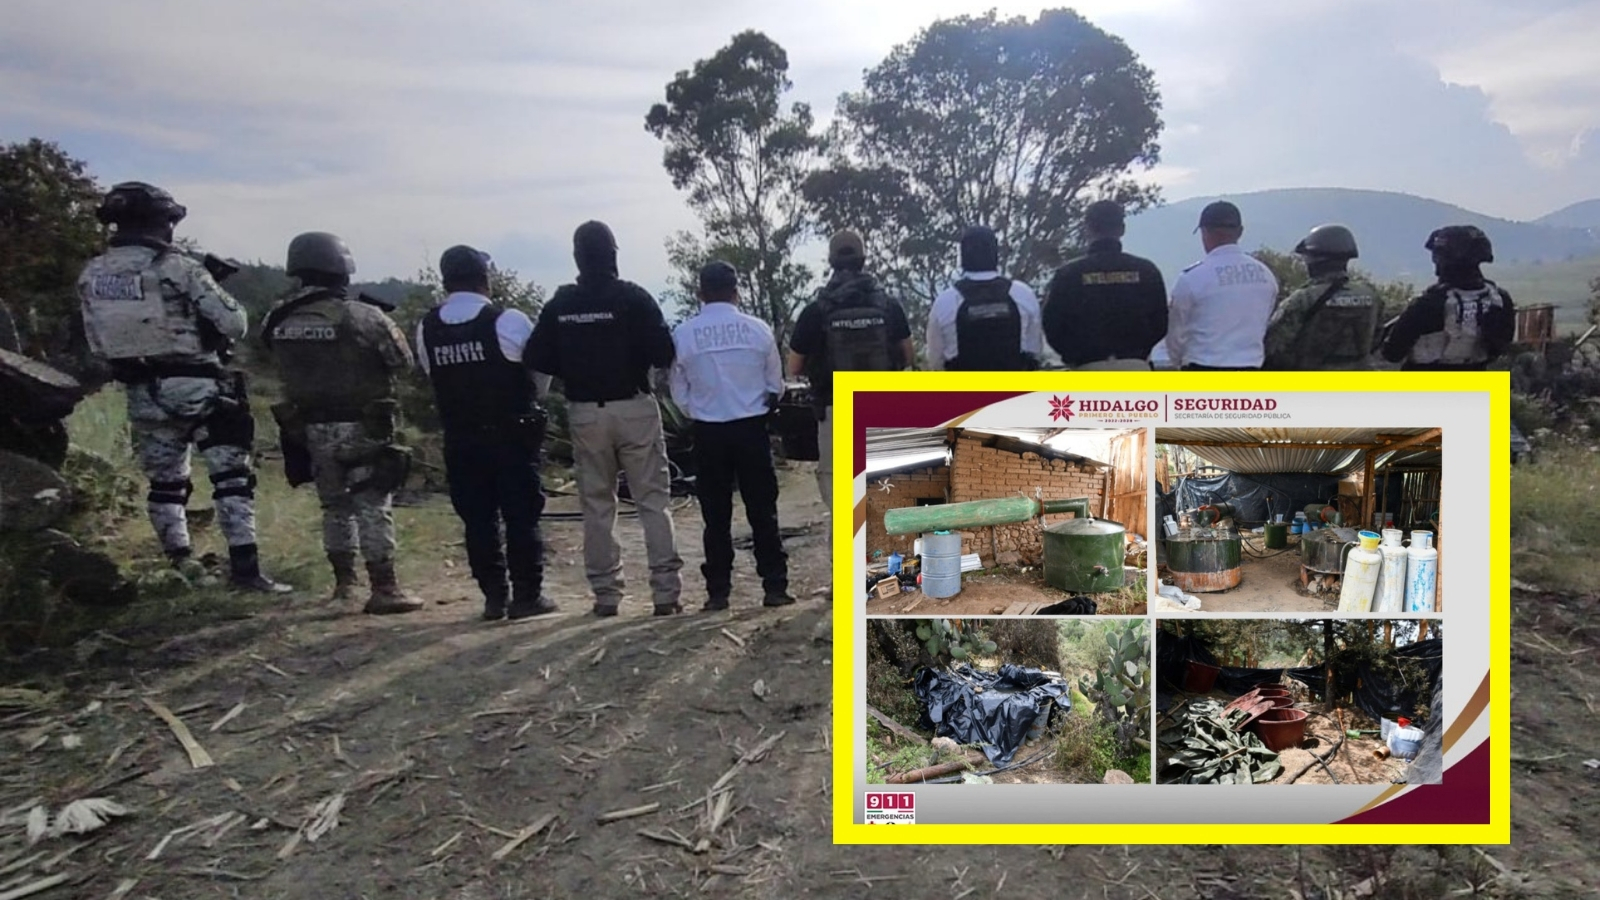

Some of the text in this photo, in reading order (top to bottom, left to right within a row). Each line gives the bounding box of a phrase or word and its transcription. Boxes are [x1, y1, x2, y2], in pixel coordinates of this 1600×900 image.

[831, 317, 885, 329] INTELIGENCIA
[273, 326, 336, 340] EJERCITO
[436, 349, 486, 366] ESTATAL
